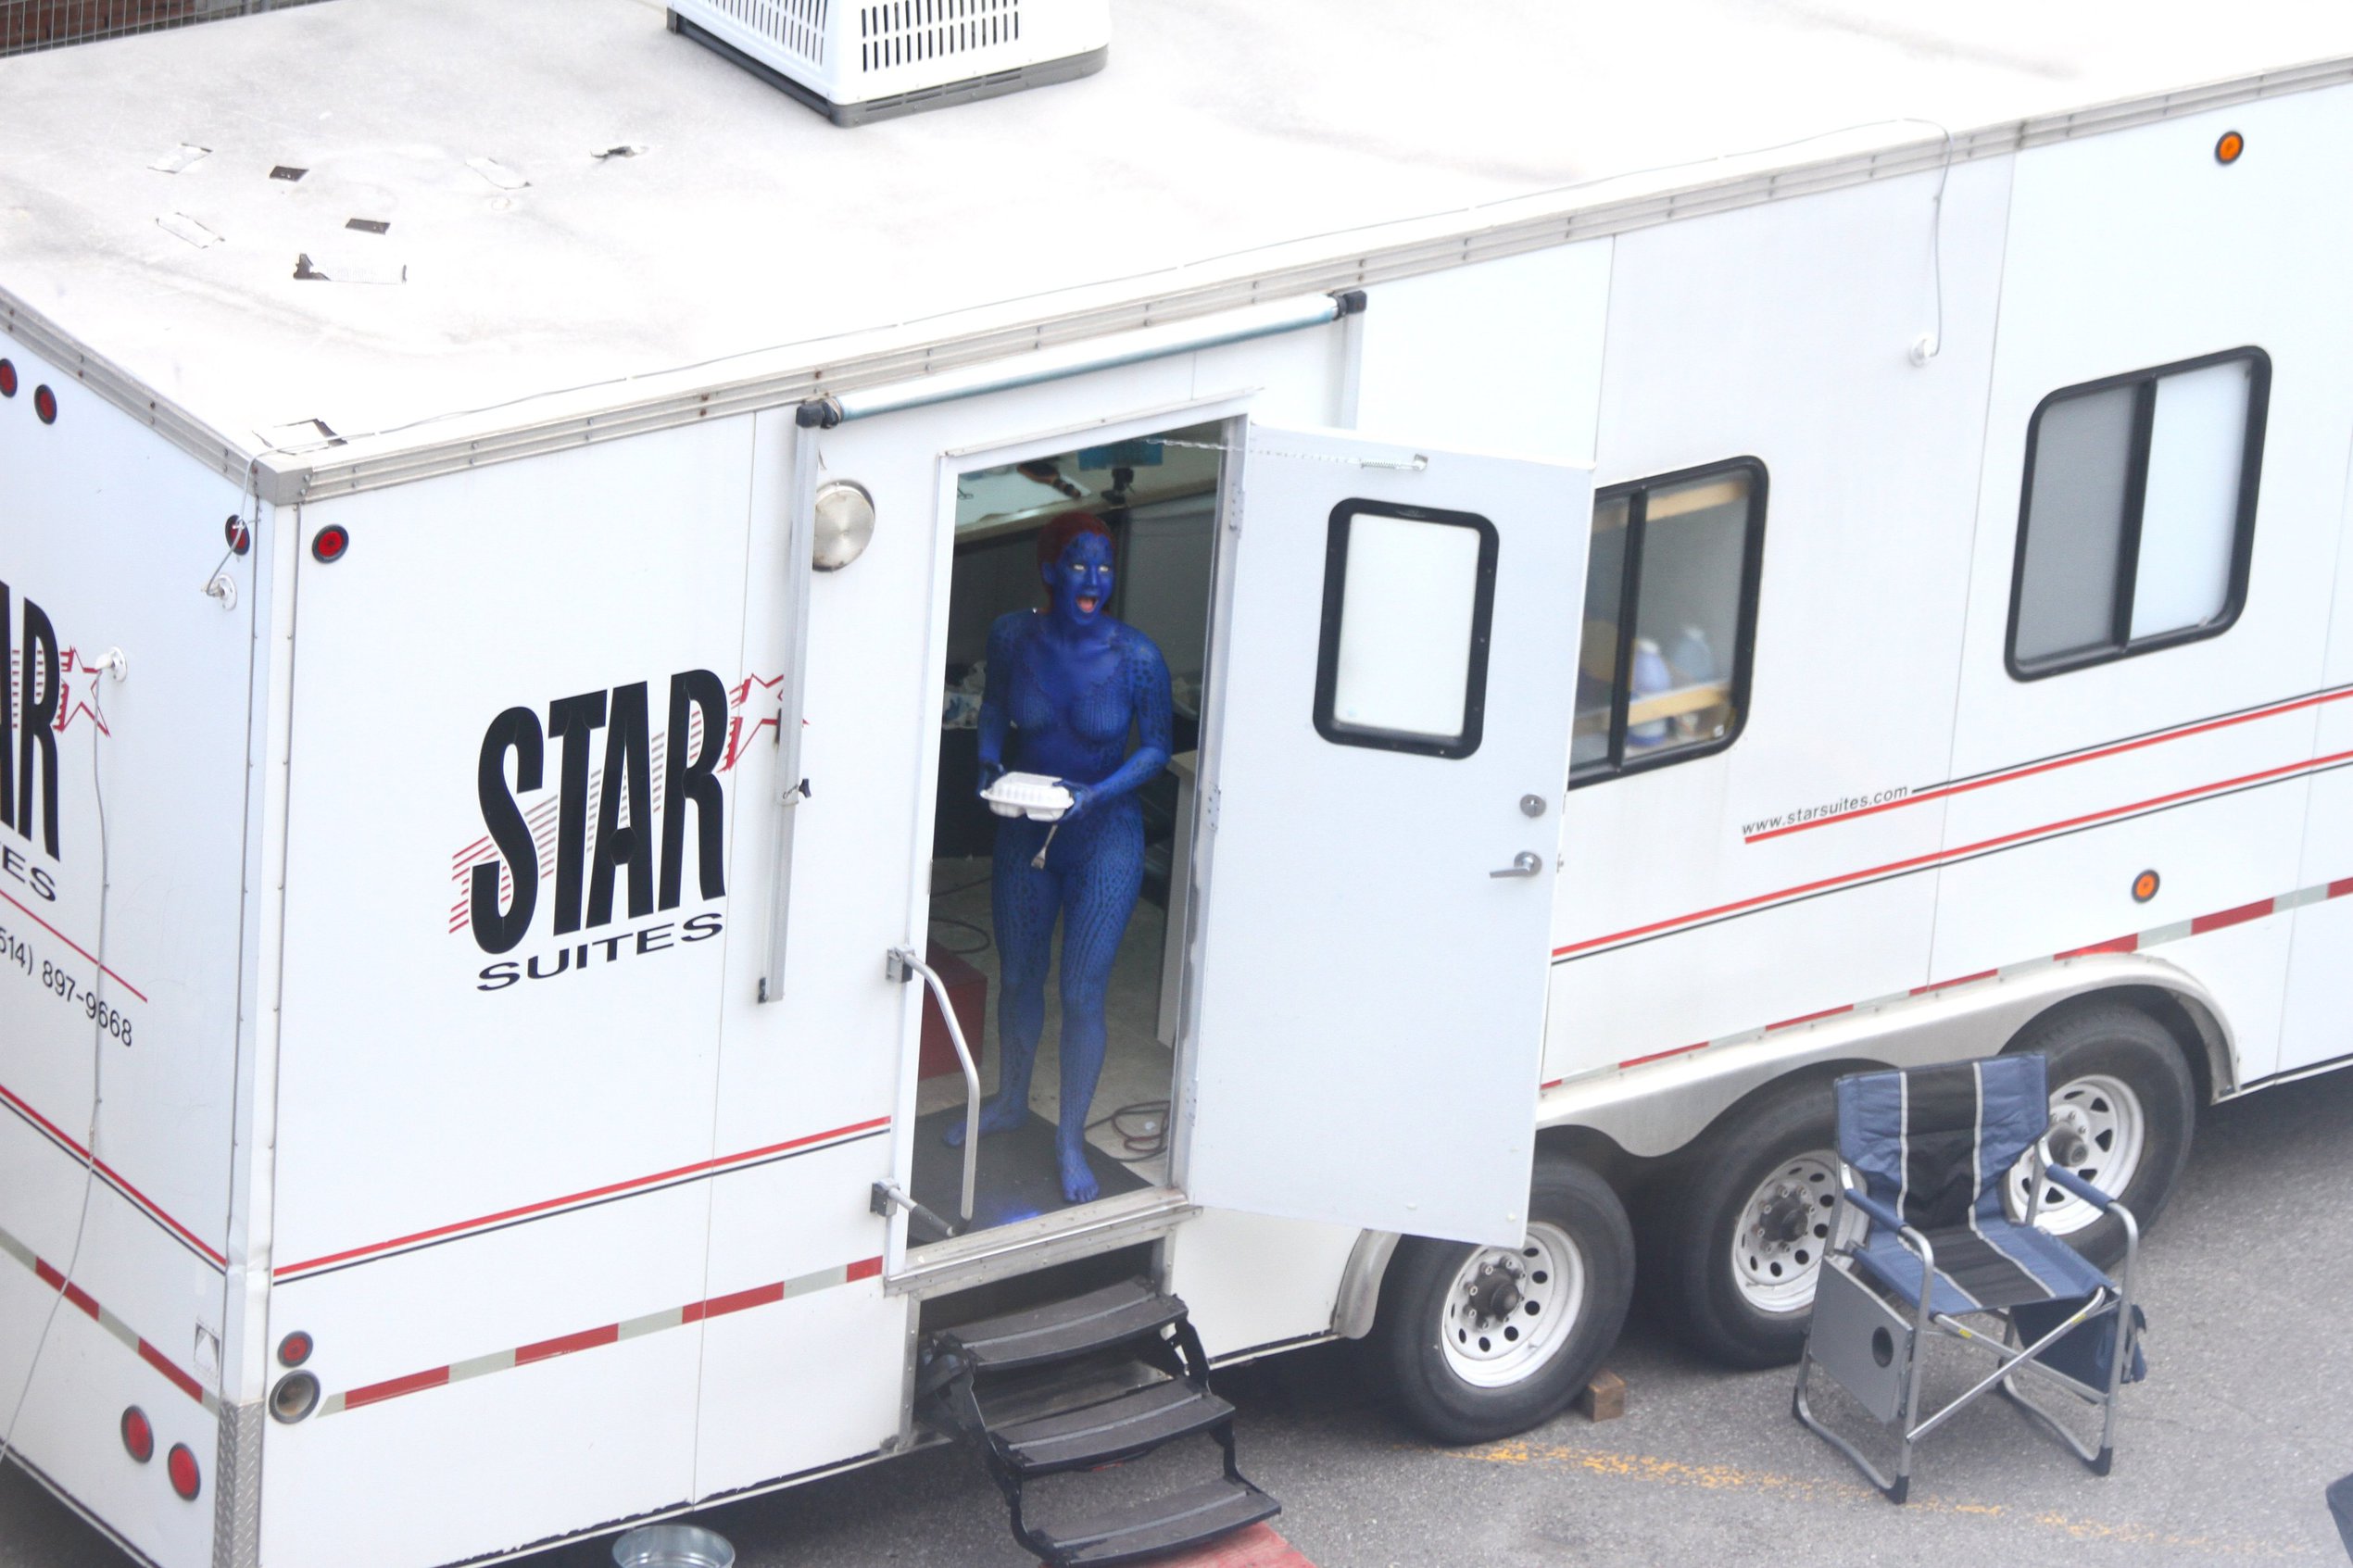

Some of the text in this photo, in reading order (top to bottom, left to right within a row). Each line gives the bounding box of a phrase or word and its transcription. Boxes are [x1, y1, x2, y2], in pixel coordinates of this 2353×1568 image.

[471, 669, 727, 955] STAR
[1742, 785, 1908, 835] www.starsuites.com
[477, 913, 724, 991] SUITES
[42, 960, 132, 1047] 897-9668
